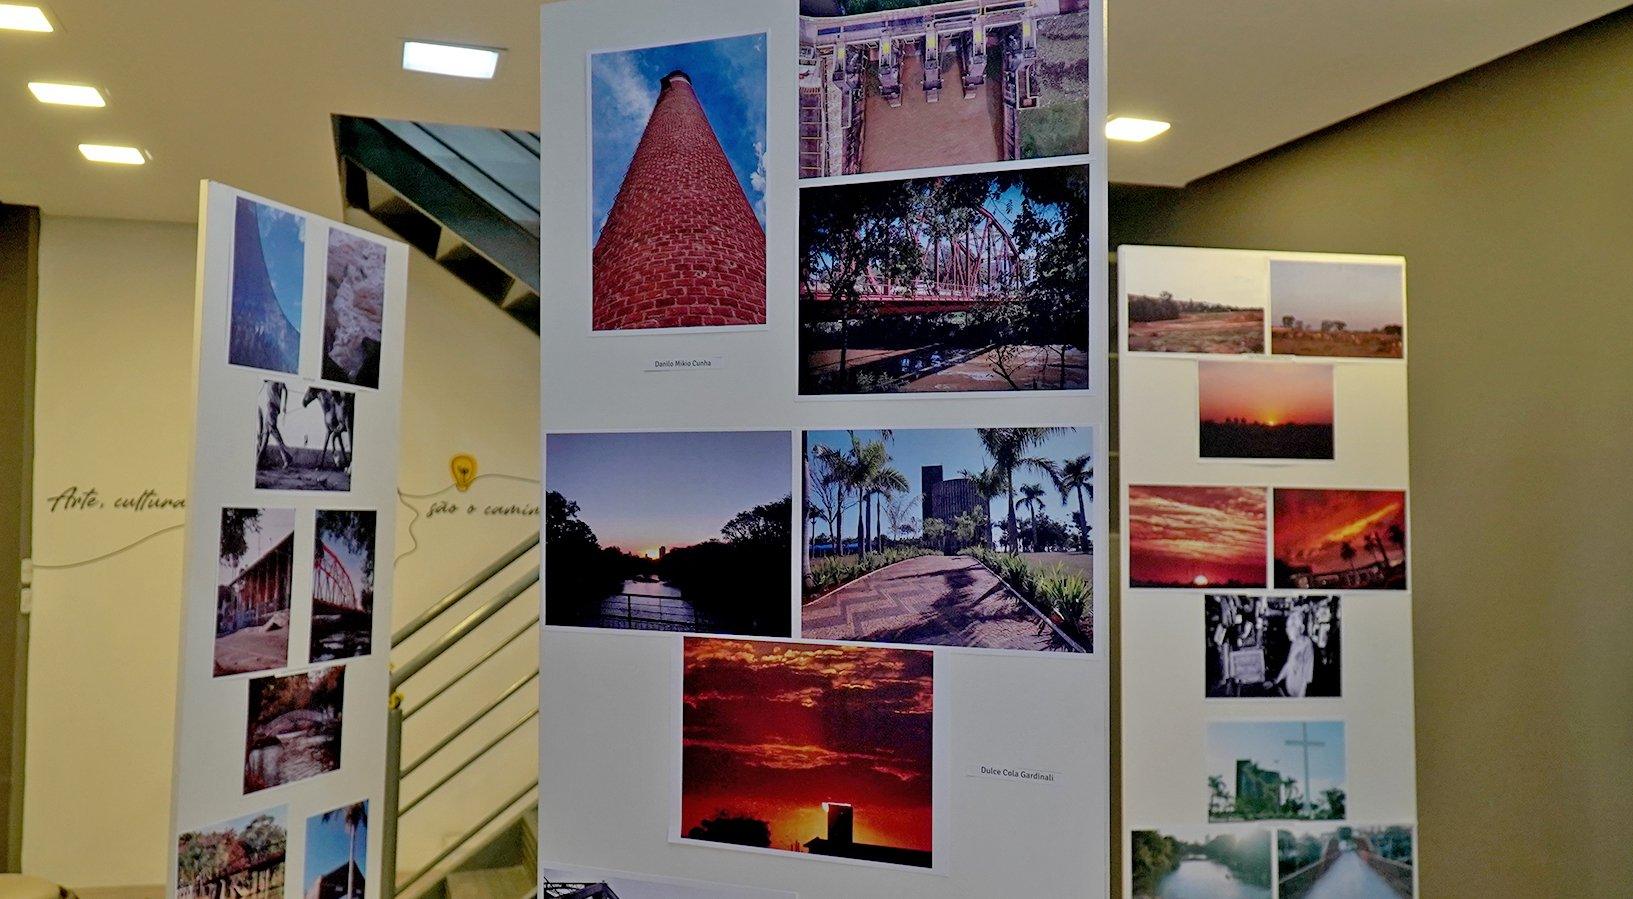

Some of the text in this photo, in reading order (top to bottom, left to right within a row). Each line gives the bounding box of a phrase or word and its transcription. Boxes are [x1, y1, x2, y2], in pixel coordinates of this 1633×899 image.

[654, 360, 674, 368] Danilo
[692, 359, 712, 367] Cunha
[47, 486, 104, 512] Arte,
[426, 501, 458, 518] são
[467, 504, 477, 515] o
[981, 766, 1001, 775] Dulce
[1020, 771, 1054, 781] Gardinali
